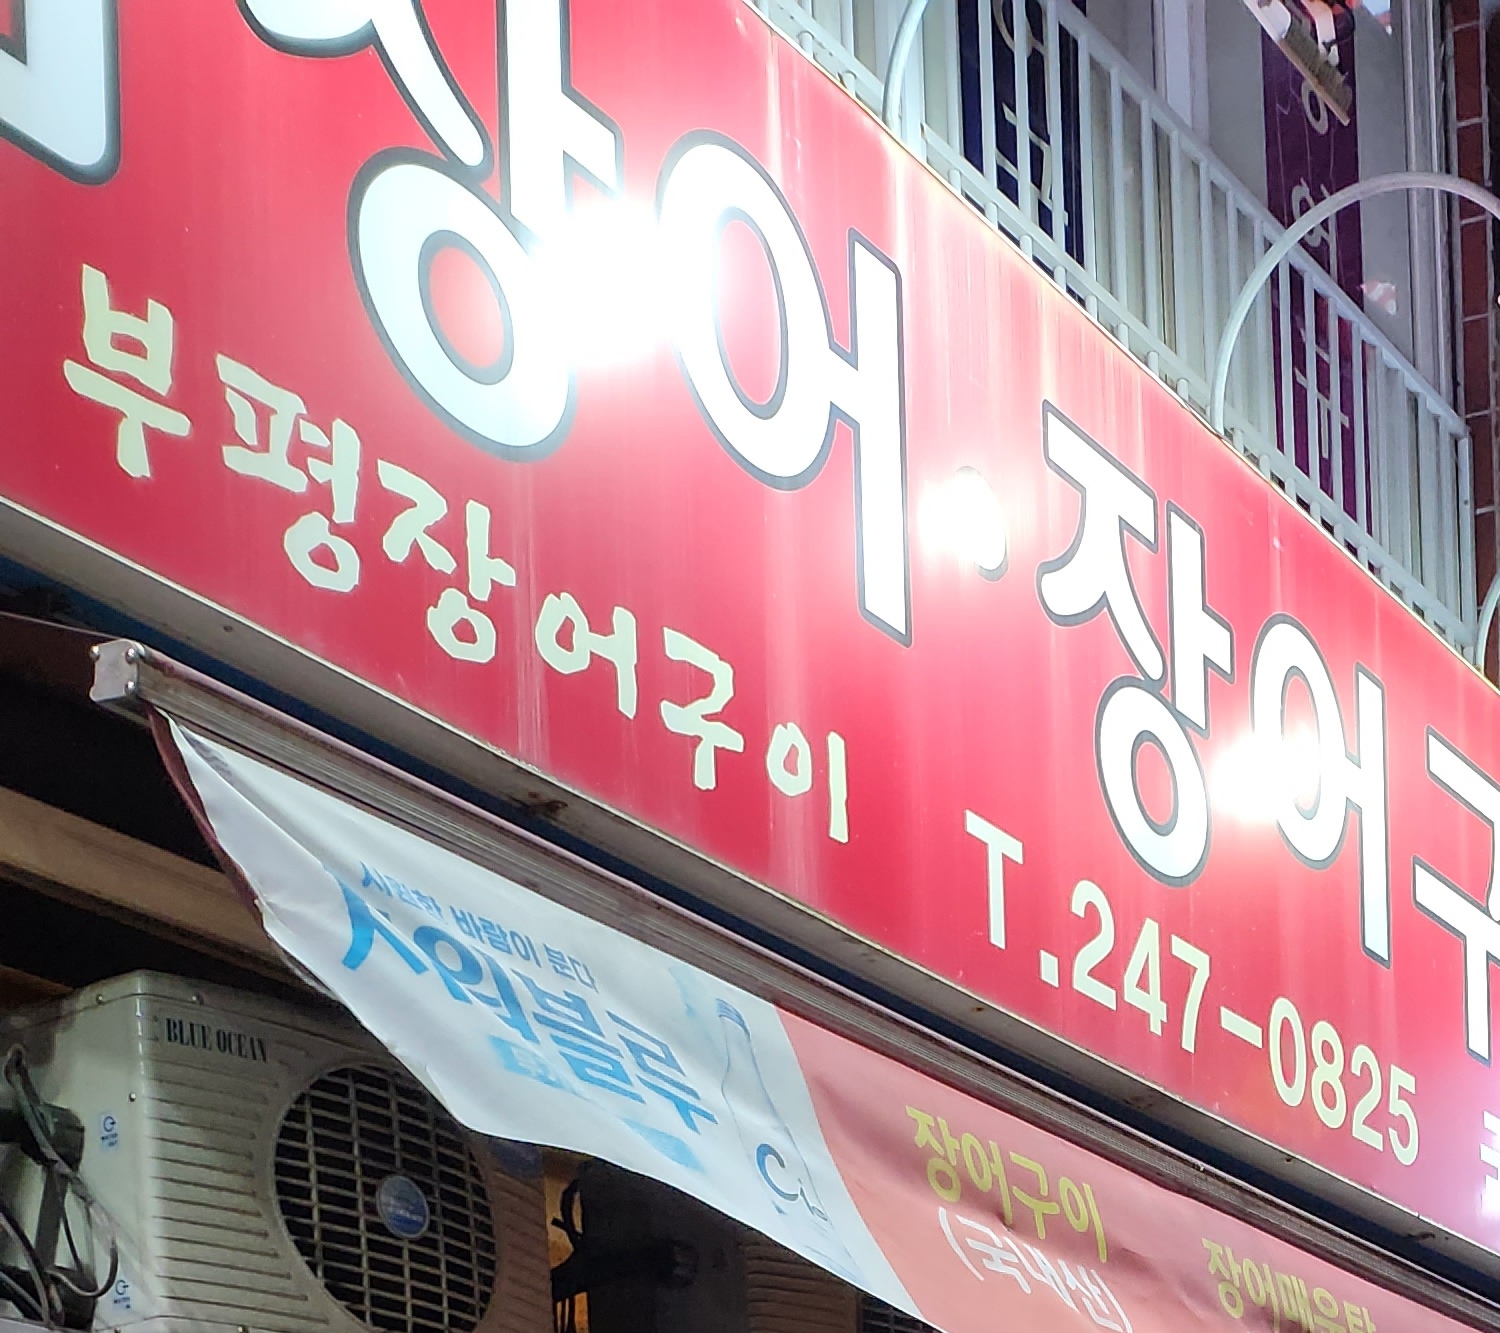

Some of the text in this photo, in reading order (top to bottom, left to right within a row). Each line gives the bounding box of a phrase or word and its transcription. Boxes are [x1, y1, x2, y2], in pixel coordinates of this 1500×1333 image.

[63, 264, 848, 844] 부평장어구이
[326, 865, 718, 1134] 시원블루
[449, 904, 542, 968] 바람이
[543, 943, 600, 994] 분다
[166, 1017, 269, 1063] BLUE OCEAN
[906, 1105, 1107, 1263] 장어구이
